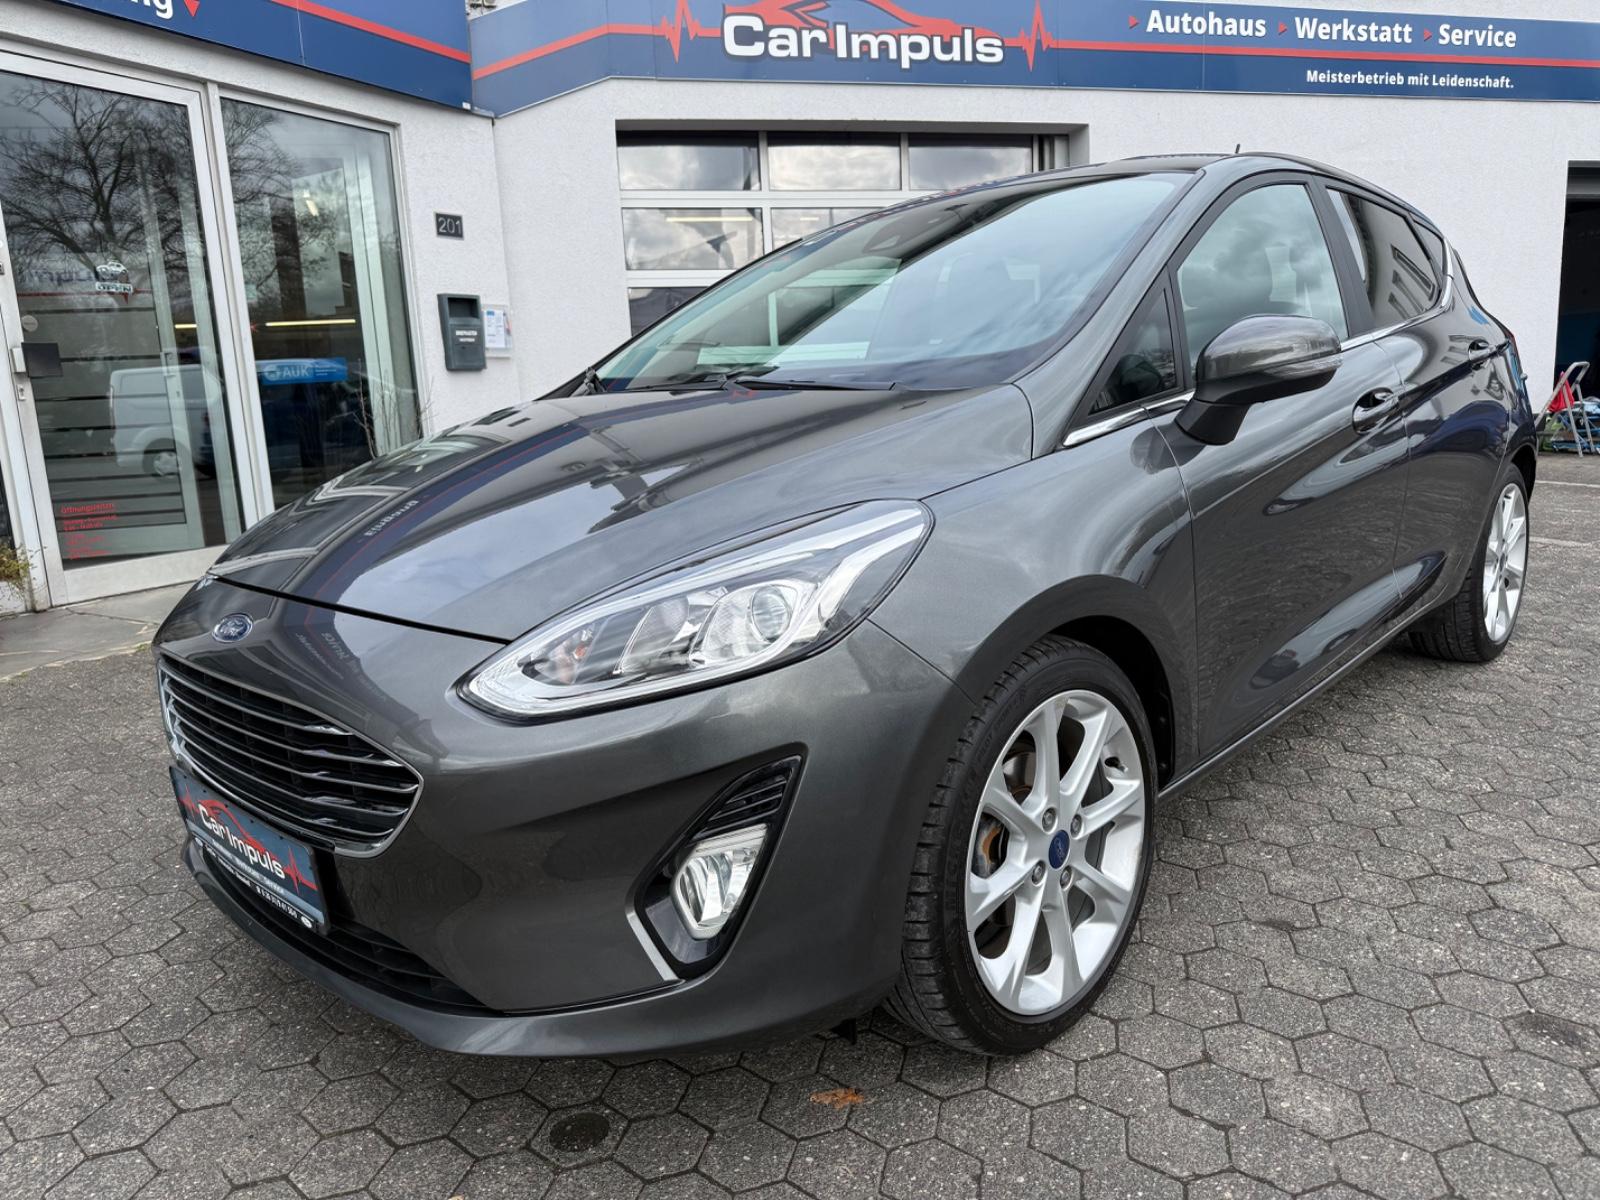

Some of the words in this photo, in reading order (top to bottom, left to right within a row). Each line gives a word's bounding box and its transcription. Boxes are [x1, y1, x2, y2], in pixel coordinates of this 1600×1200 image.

[722, 14, 1004, 70] CarImpuls
[1146, 9, 1267, 38] Autohaus
[1294, 16, 1413, 44] Werkstatt
[1438, 23, 1517, 48] Service
[1306, 69, 1404, 86] Meisterbetrieb
[1407, 72, 1429, 87] mit
[1431, 72, 1514, 89] Leidenschaft.
[438, 217, 462, 235] 201
